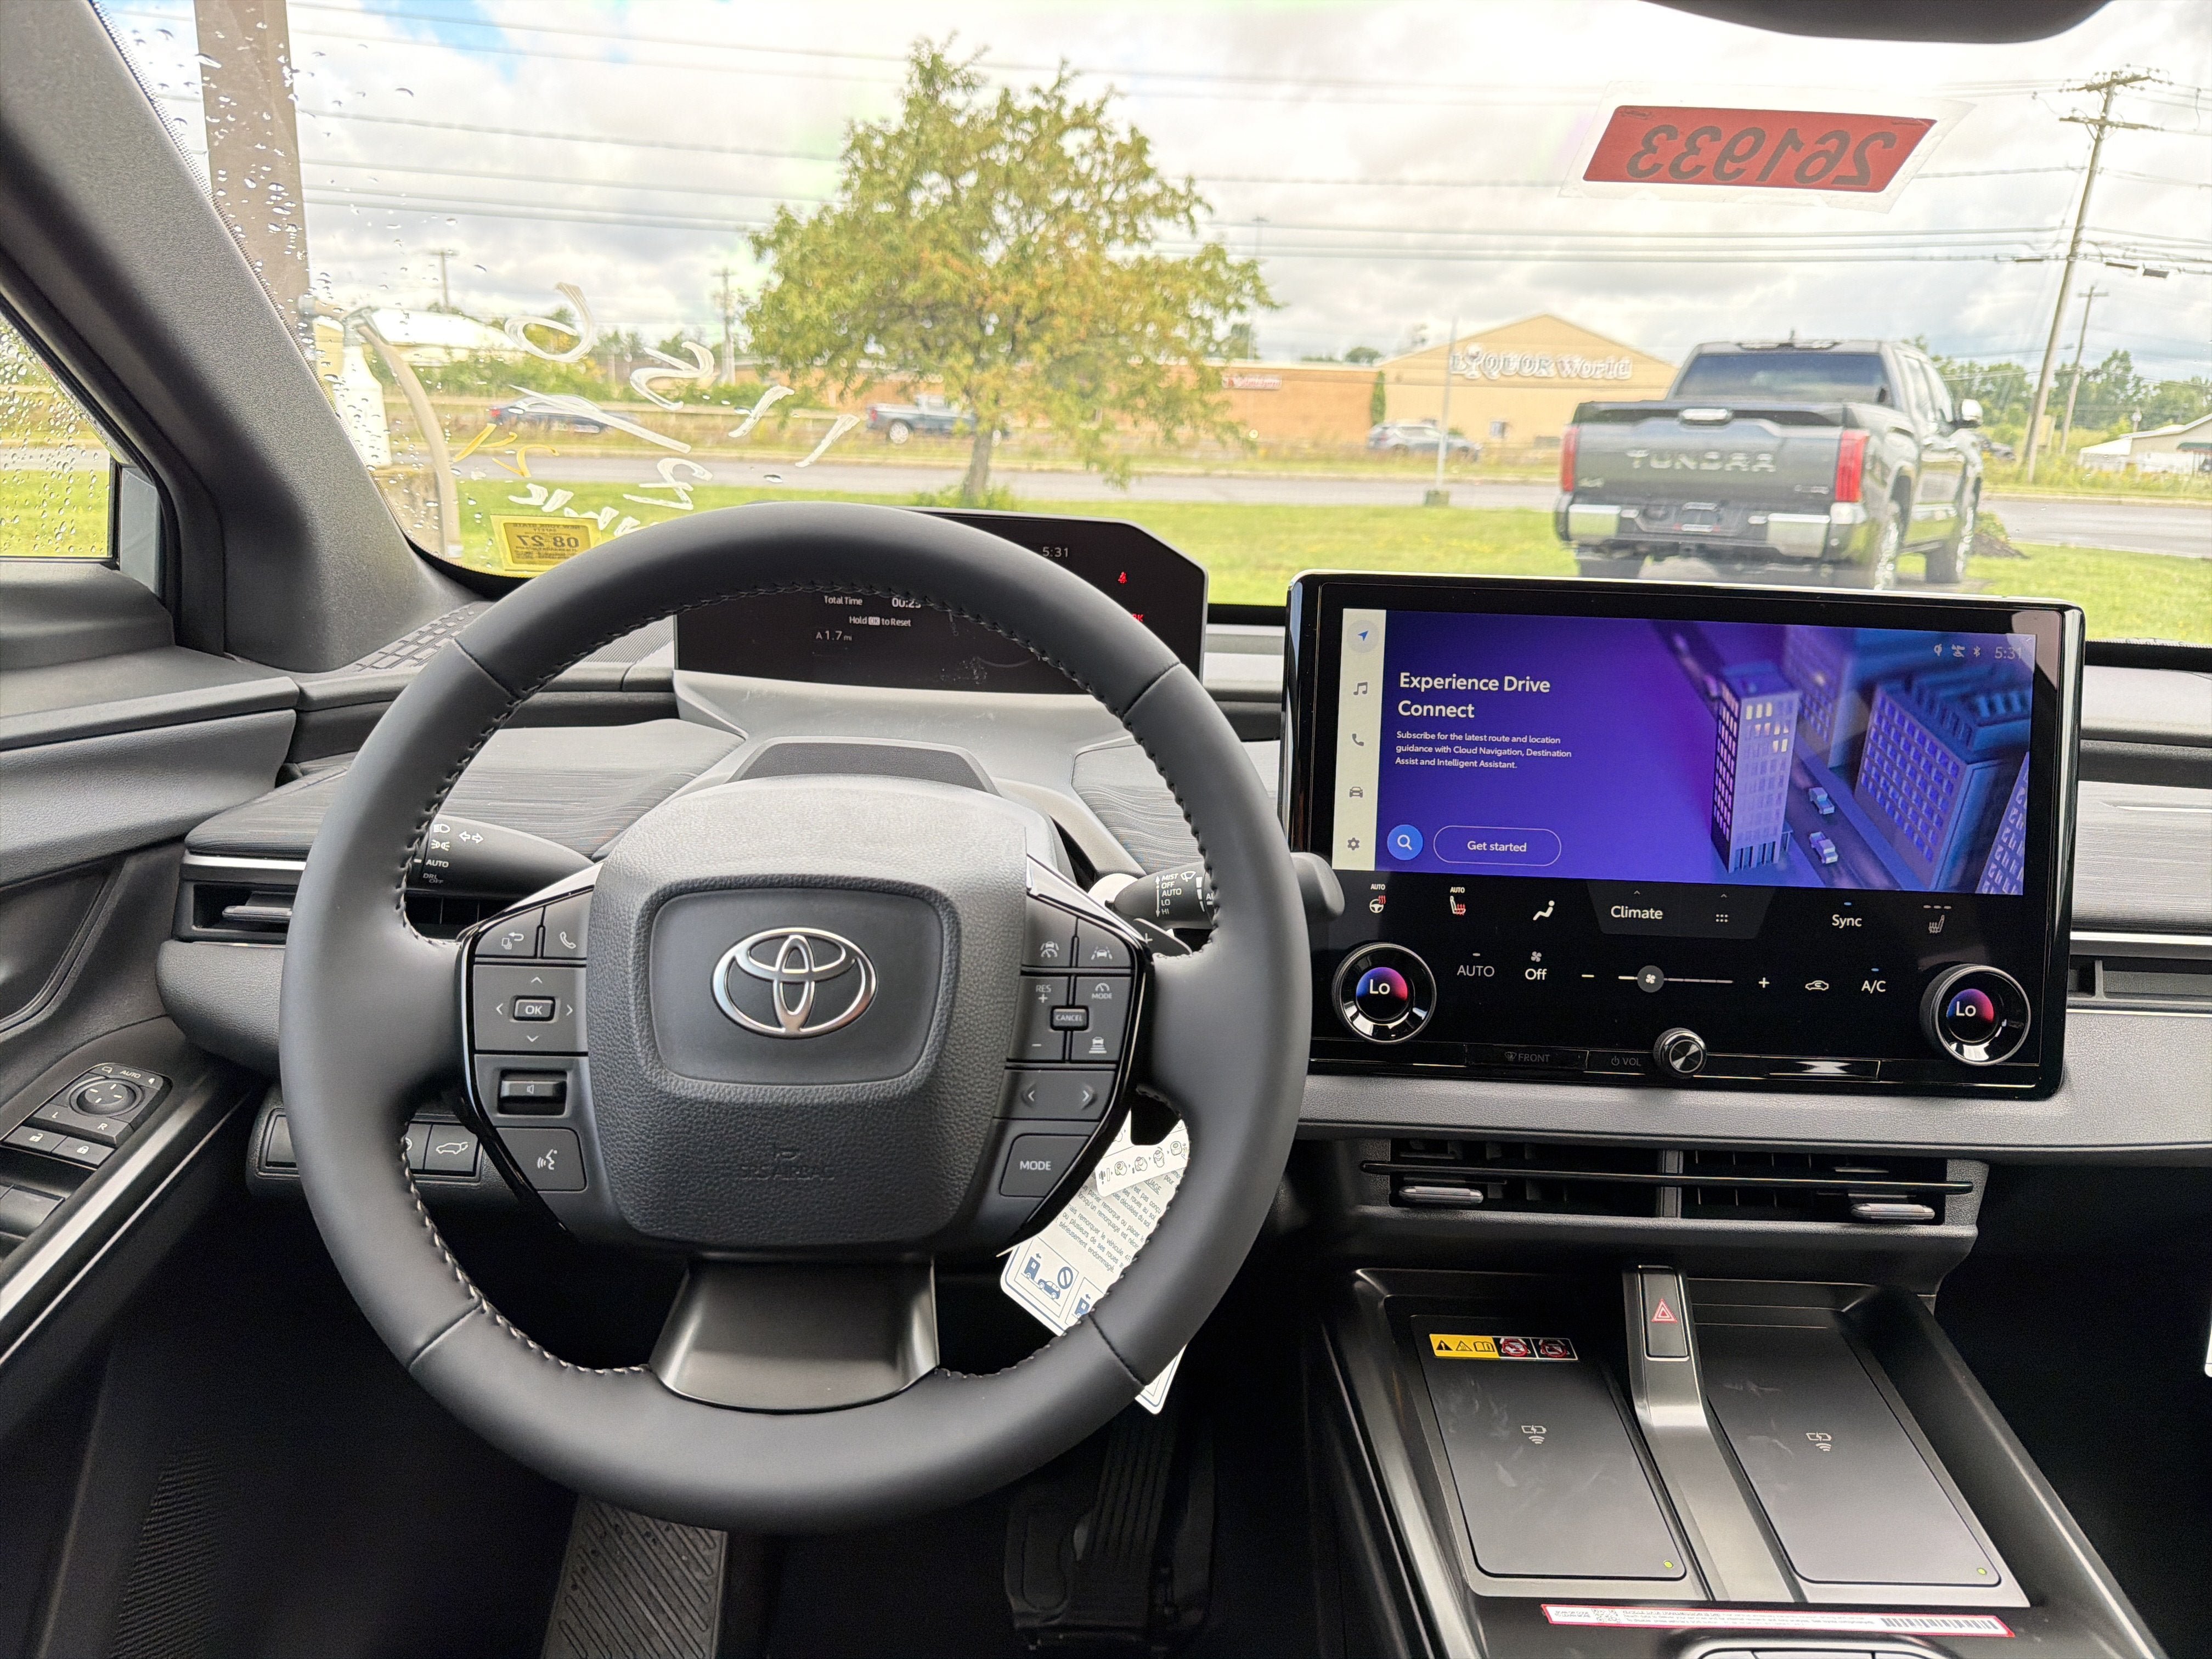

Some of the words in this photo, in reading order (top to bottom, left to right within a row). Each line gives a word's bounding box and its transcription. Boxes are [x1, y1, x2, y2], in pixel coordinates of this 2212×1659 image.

[1557, 354, 1633, 380] World
[1626, 449, 1776, 472] TUNDRA
[1042, 546, 1069, 557] 5:31
[825, 596, 844, 605] Total
[844, 597, 863, 606] Time
[849, 616, 867, 625] Hold
[891, 618, 911, 627] Reset
[825, 630, 843, 641] 1.7
[1994, 646, 2022, 659] 5:31
[1400, 673, 1499, 692] Experience
[1504, 676, 1550, 693] Drive
[1398, 700, 1475, 718] Connect
[1396, 731, 1436, 740] Subscribe
[1529, 736, 1561, 744] location
[1396, 744, 1433, 754] guidance
[1453, 746, 1477, 754] Cloud
[1479, 747, 1525, 757] Navigation,
[1526, 748, 1572, 758] Destination
[1437, 759, 1477, 768] Intelligent
[1479, 760, 1517, 769] Assistant.
[1466, 840, 1488, 852] Get
[1489, 841, 1527, 853] started
[426, 859, 449, 868] AUTO
[1161, 873, 1179, 882] MIST
[1161, 888, 1182, 898] AUTO
[1611, 906, 1663, 920] Climate
[1831, 914, 1862, 929] Sync
[1457, 965, 1495, 978] AUTO
[1525, 968, 1547, 981] Off
[1036, 985, 1052, 993] RES
[1369, 979, 1390, 995] Lo
[1861, 980, 1886, 994] A/C
[1091, 992, 1113, 1000] MODE
[525, 1005, 543, 1015] OK
[1956, 1001, 1976, 1017] Lo
[1056, 1014, 1083, 1022] CANCEL
[1518, 1052, 1550, 1064] FRONT
[1622, 1056, 1641, 1067] VOL
[120, 1070, 142, 1079] AUTO
[97, 1122, 108, 1131] R
[1019, 1160, 1052, 1171] MODE
[1139, 1192, 1150, 1203] pas
[1119, 1218, 1127, 1227] ou
[1061, 1211, 1070, 1220] ou
[1089, 1235, 1098, 1244] de
[1096, 1242, 1107, 1252] ses
[1105, 1250, 1120, 1264] roues
[1099, 1232, 1107, 1240] le
[1119, 1231, 1128, 1240] est
